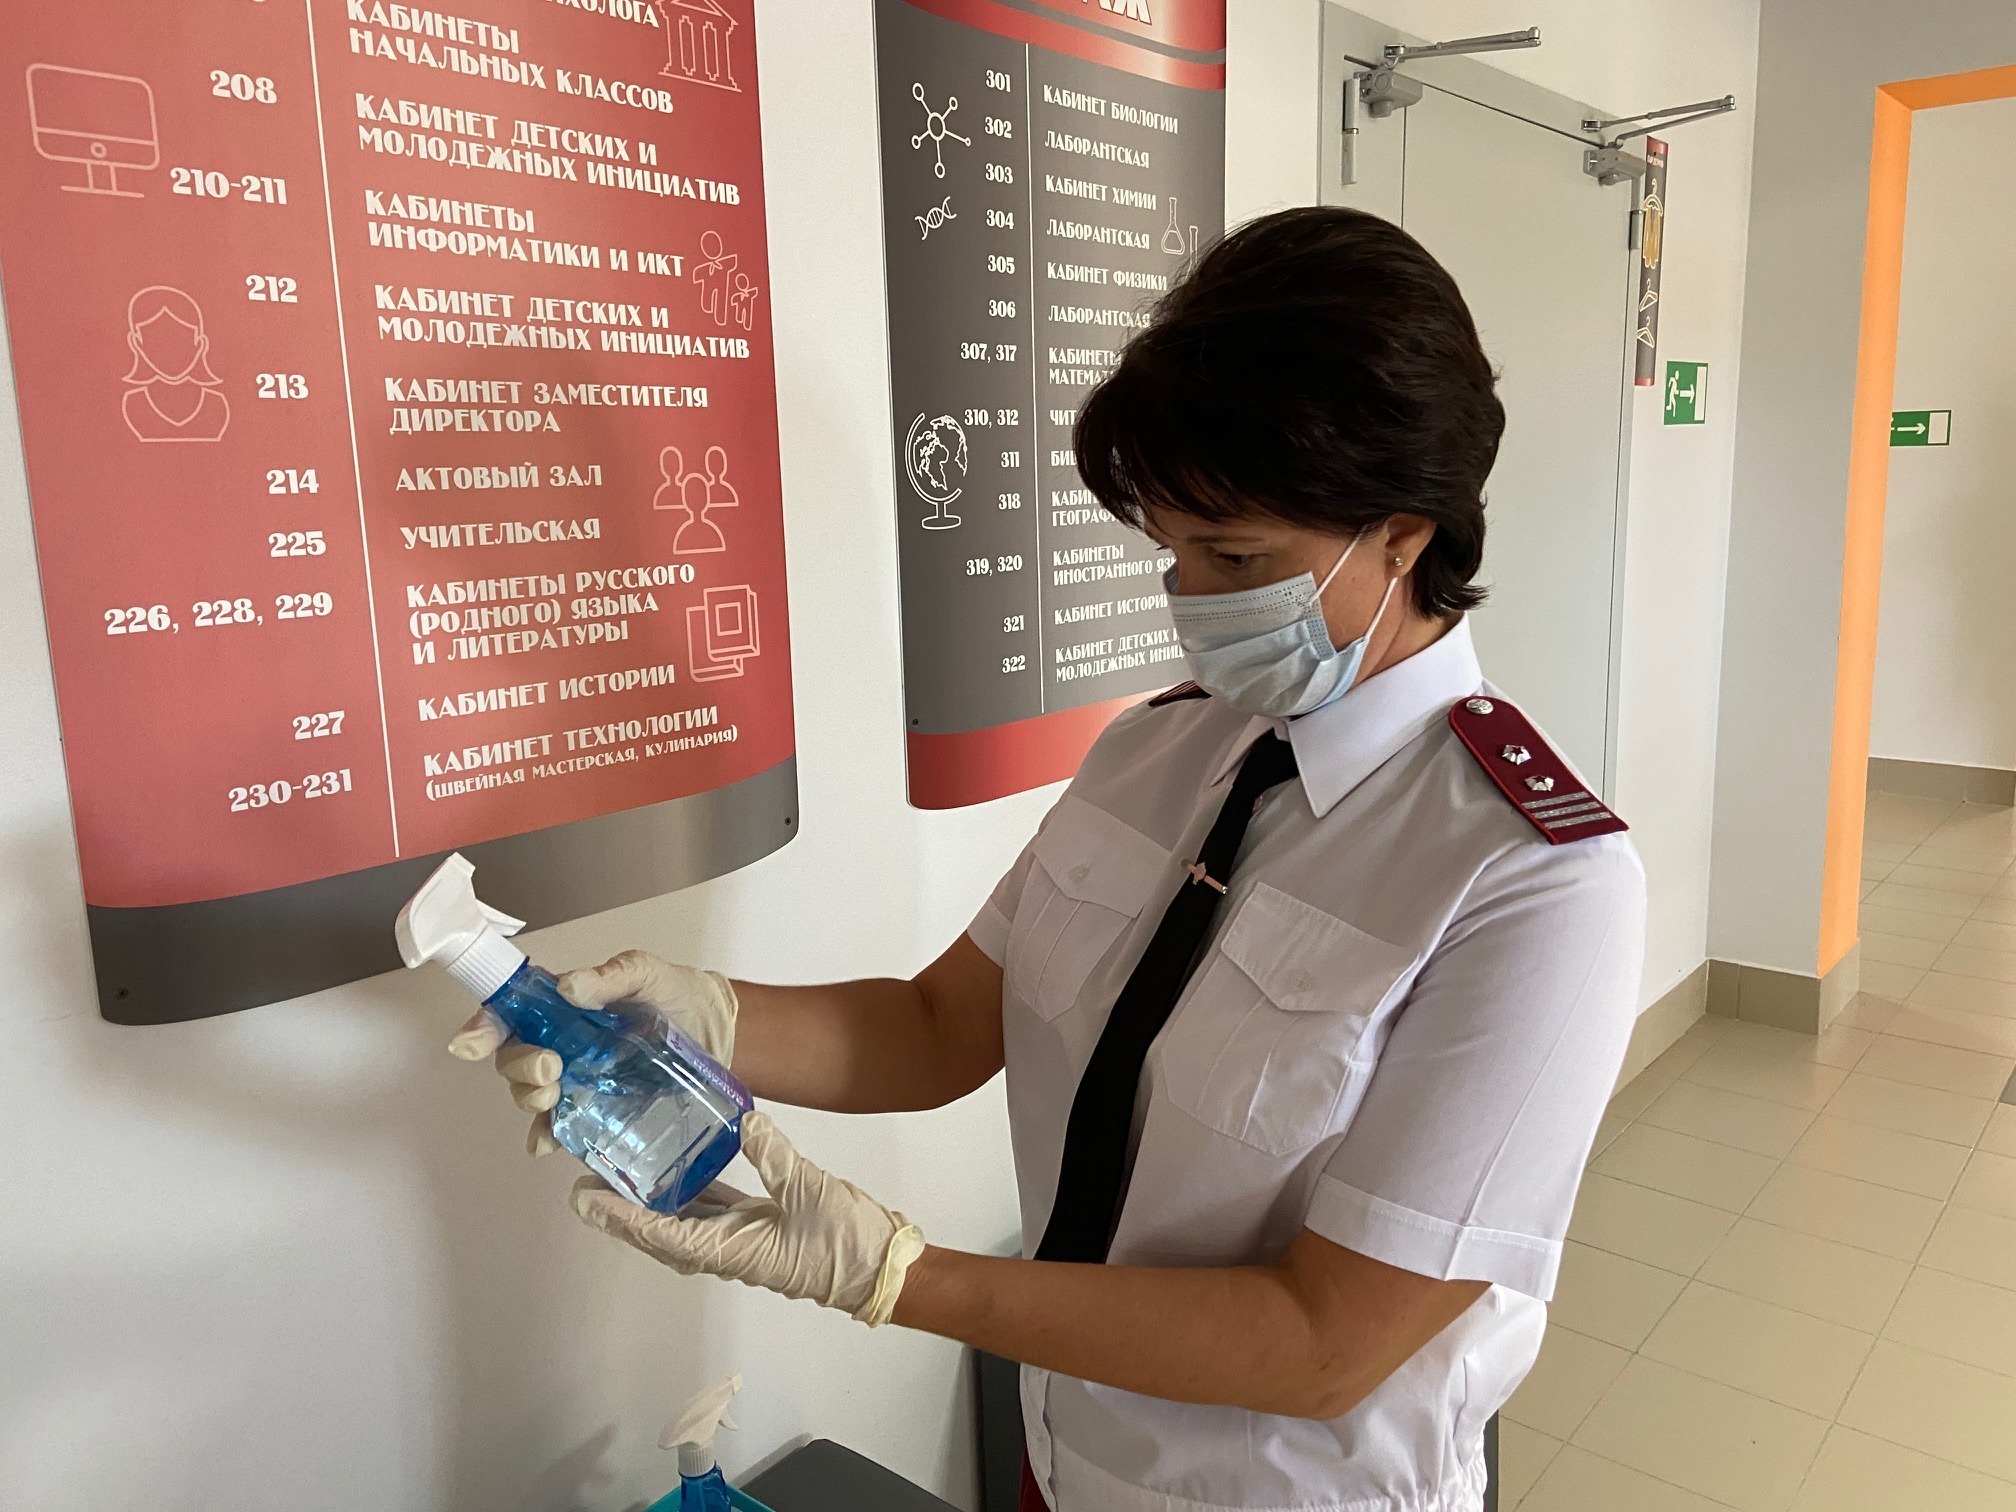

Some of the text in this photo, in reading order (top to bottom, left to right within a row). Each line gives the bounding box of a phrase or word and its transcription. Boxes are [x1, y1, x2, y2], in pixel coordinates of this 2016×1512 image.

[347, 0, 519, 54] КАБИНЕТЫ
[349, 28, 673, 114] НАЧАЛЬНЫХ КЛАССОВ
[986, 70, 1011, 92] 301
[210, 70, 277, 104] 208
[1044, 85, 1178, 134] КАБИНЕТ БИОЛОГИИ
[356, 93, 657, 166] КАБИНЕТ ДЕТСКИХ И
[985, 117, 1012, 139] 302
[1045, 131, 1149, 168] ЛАБОРАНТСКАЯ
[358, 125, 740, 206] МОЛОДЕЖНЫХ ИНИЦИАТИВ
[986, 163, 1013, 184] 303
[170, 167, 287, 205] 210-211
[1046, 175, 1156, 210] КАБИНЕТ ХИМИИ
[365, 189, 535, 233] КАБИНЕТЫ
[986, 210, 1014, 229] 304
[368, 221, 684, 277] ИНФОРМАТИКИ И ИКТ
[1047, 219, 1149, 249] ЛАБОРАНТСКАЯ
[988, 255, 1015, 274] 305
[1048, 262, 1167, 290] КАБИНЕТ ФИЗИКИ
[246, 275, 298, 303] 212
[374, 285, 668, 328] КАБИНЕТ ДЕТСКИХ И
[989, 300, 1016, 318] 306
[1048, 305, 1150, 328] ЛАБОРАНТСКАЯ
[378, 316, 750, 359] МОЛОДЕЖНЫХ ИНИЦИАТИВ
[960, 342, 1017, 363] 307, 317
[256, 373, 309, 399] 213
[385, 377, 707, 408] КАБИНЕТ ЗАМЕСТИТЕЛЯ
[389, 408, 561, 435] ДИРЕКТОРА
[964, 409, 1019, 428] 310, 312
[1000, 451, 1020, 468] 311
[266, 469, 319, 494] 214
[396, 462, 602, 491] АКТОВЫЙ ЗАЛ
[998, 493, 1021, 510] 318
[1052, 489, 1099, 507] КАБИН
[268, 531, 326, 557] 225
[400, 519, 600, 549] УЧИТЕЛЬСКАЯ
[966, 555, 1023, 576] 319, 320
[1053, 544, 1124, 567] КАБИНЕТЫ
[406, 564, 694, 608] КАБИНЕТЫ РУССКОГО
[1053, 560, 1152, 586] ИНОСТРАННОГО
[104, 592, 333, 635] 226, 228, 229
[410, 593, 659, 639] (РОДНОГО) ЯЗЫКА
[1003, 615, 1024, 633] 321
[1054, 602, 1113, 626] КАБИНЕТ
[412, 621, 628, 665] И ЛИТЕРАТУРЫ
[1055, 639, 1113, 664] КАБИНЕТ
[1118, 629, 1169, 653] ДЕТСКИХ
[1002, 655, 1026, 674] 322
[1056, 651, 1146, 683] МОЛОДЕЖНЫХ
[418, 664, 675, 721] КАБИНЕТ ИСТОРИИ
[293, 710, 345, 740] 227
[424, 705, 718, 777] КАБИНЕТ ТЕХНОЛОГИИ
[426, 725, 738, 802] (ШВЕЙНАЯ МАСТЕРСКАЯ, КУЛИНАРИЯ)
[229, 769, 352, 812] 230-231
